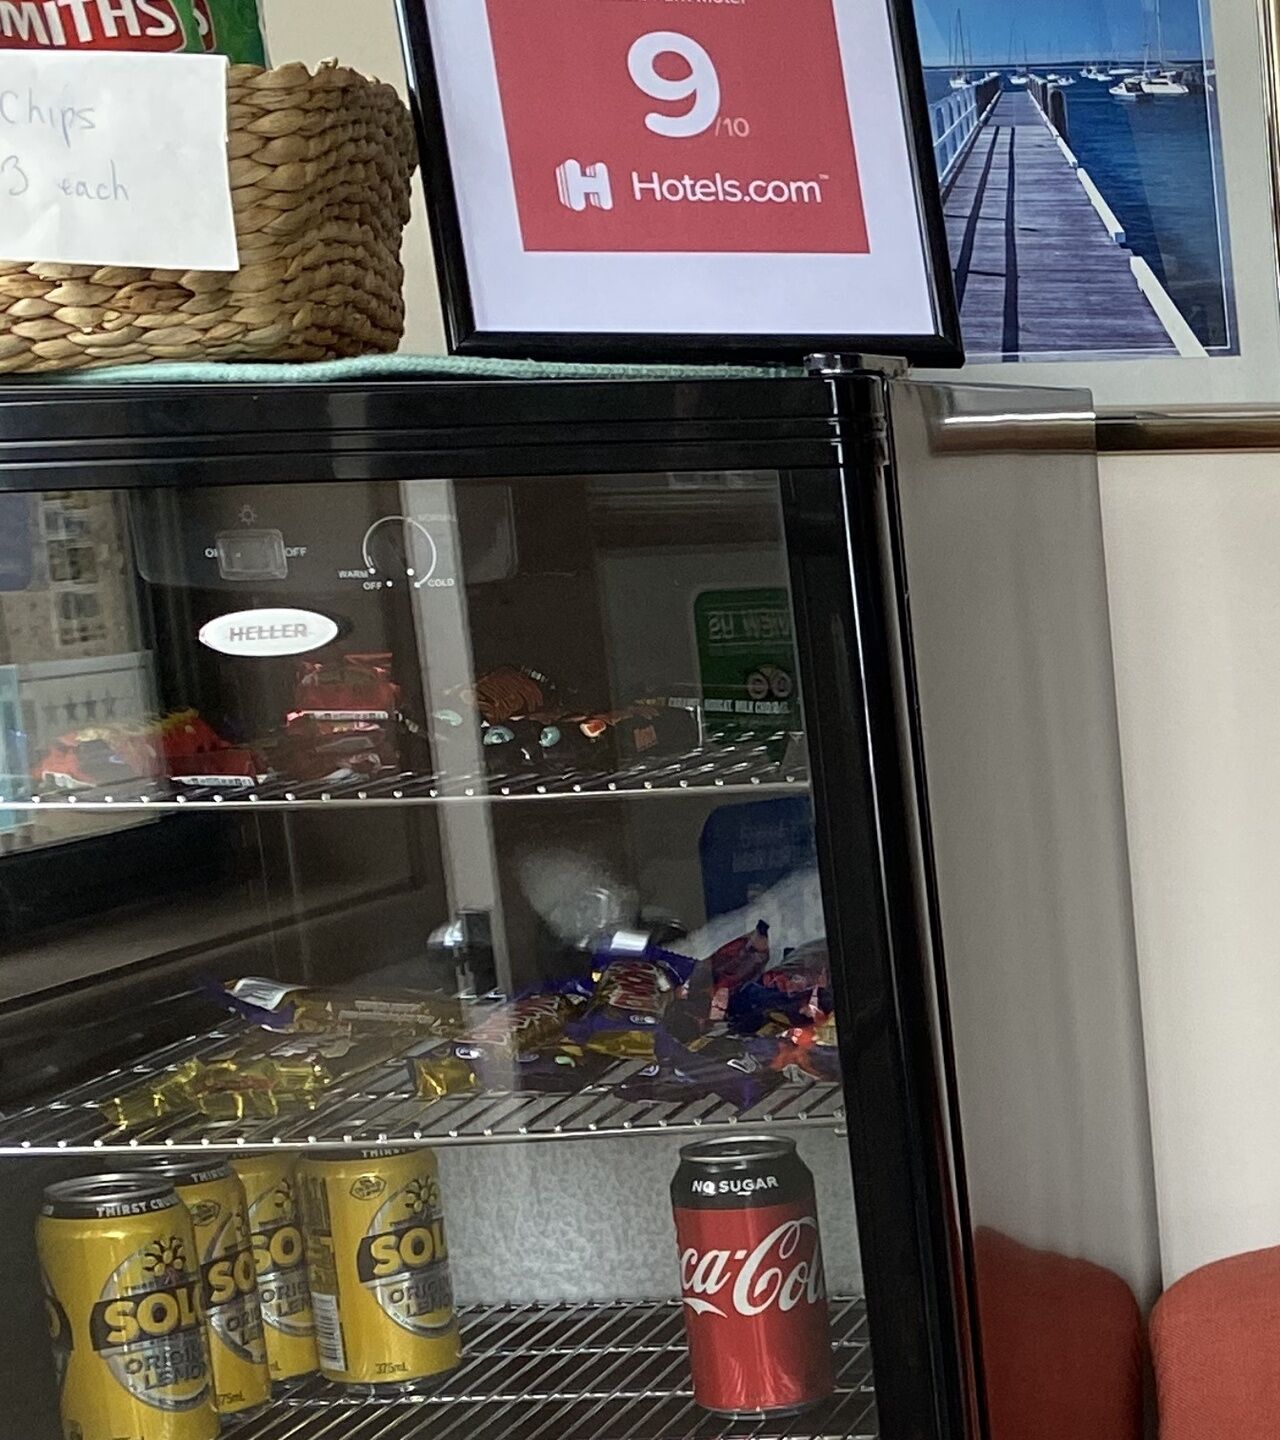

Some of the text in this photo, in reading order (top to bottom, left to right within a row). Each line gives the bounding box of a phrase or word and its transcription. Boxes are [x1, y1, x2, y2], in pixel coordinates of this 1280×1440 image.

[627, 31, 720, 138] 9
[631, 170, 823, 204] Hotels.com
[362, 580, 383, 591] OFF
[427, 577, 455, 588] COLD
[228, 623, 309, 643] HELLER
[692, 1176, 779, 1195] NO SUGAR
[96, 1201, 147, 1219] THIRST
[252, 1226, 301, 1273] SO
[371, 1218, 448, 1276] SOL
[208, 1251, 257, 1304] SO
[218, 1391, 245, 1405] 75mL
